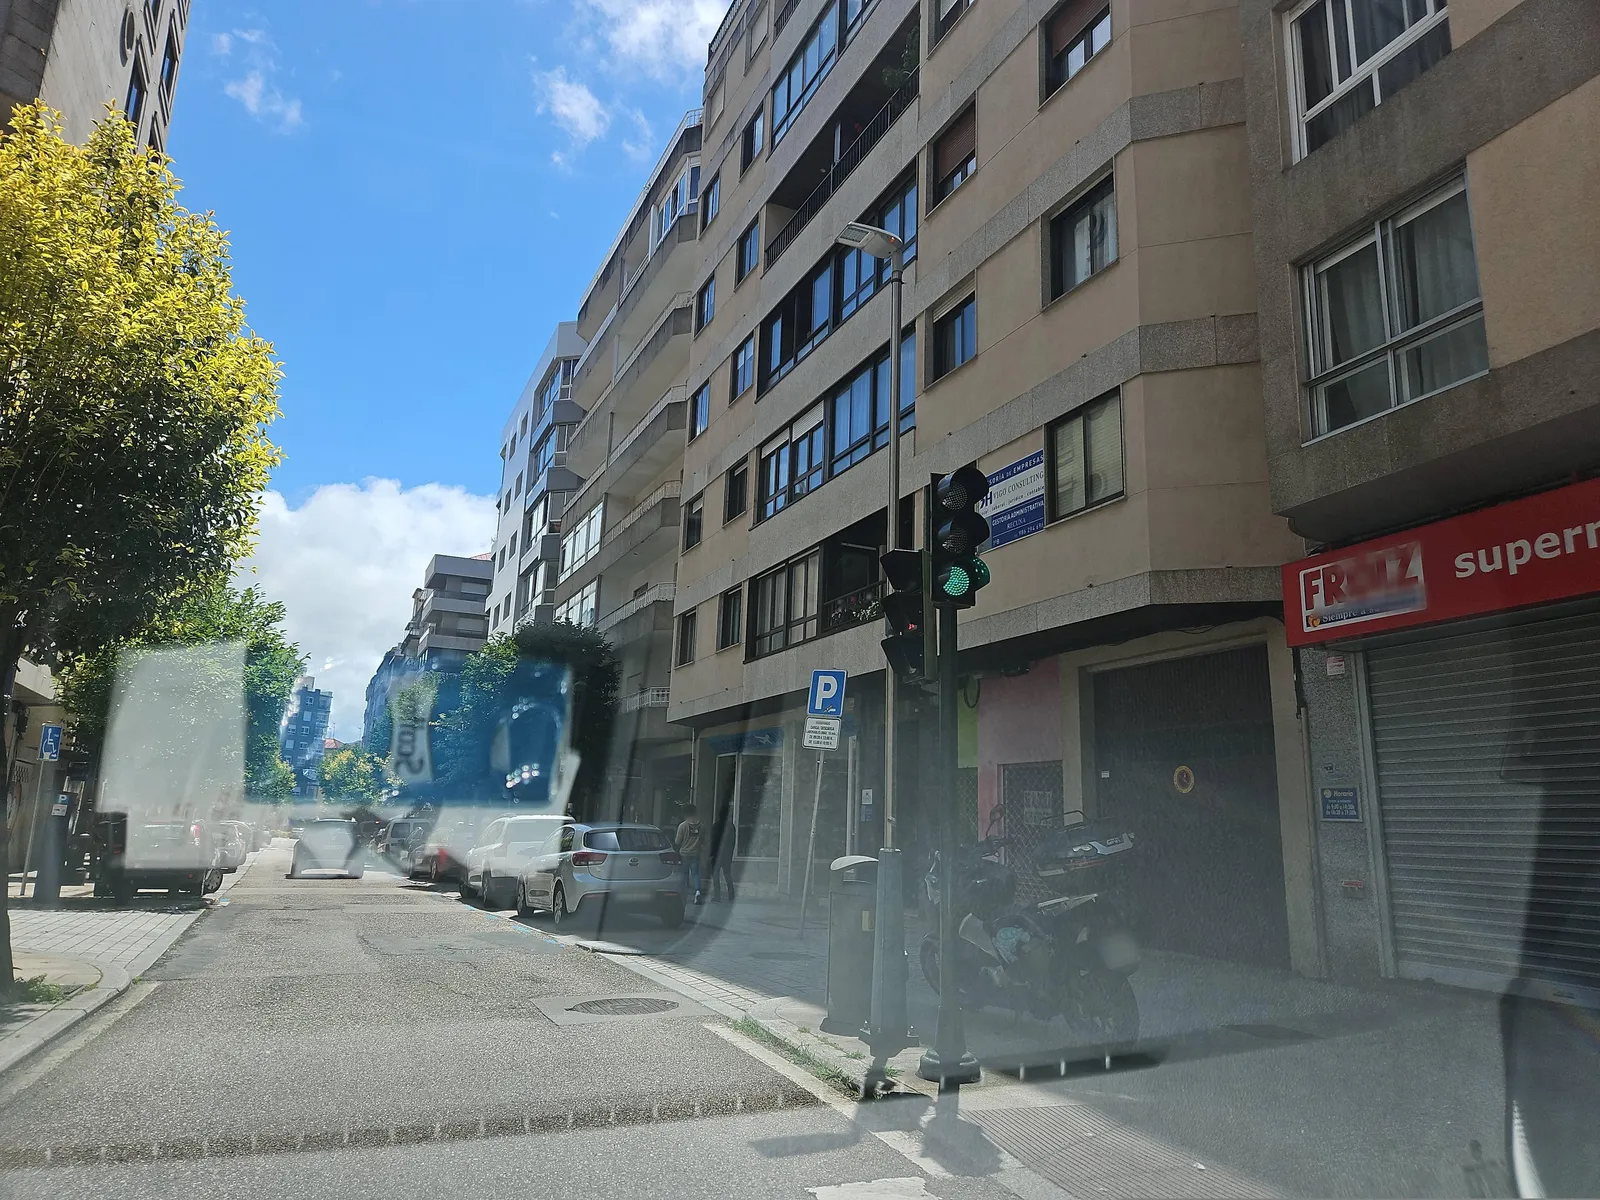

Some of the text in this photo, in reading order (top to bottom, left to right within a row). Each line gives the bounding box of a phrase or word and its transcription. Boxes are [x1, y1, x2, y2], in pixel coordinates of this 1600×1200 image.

[1013, 455, 1044, 474] EMPRESAS
[993, 487, 1007, 500] VIGO
[1007, 470, 1044, 494] CONSULTING
[1011, 500, 1044, 519] ADMINISTRATIVA
[1322, 610, 1358, 623] Siempre
[815, 676, 838, 709] P
